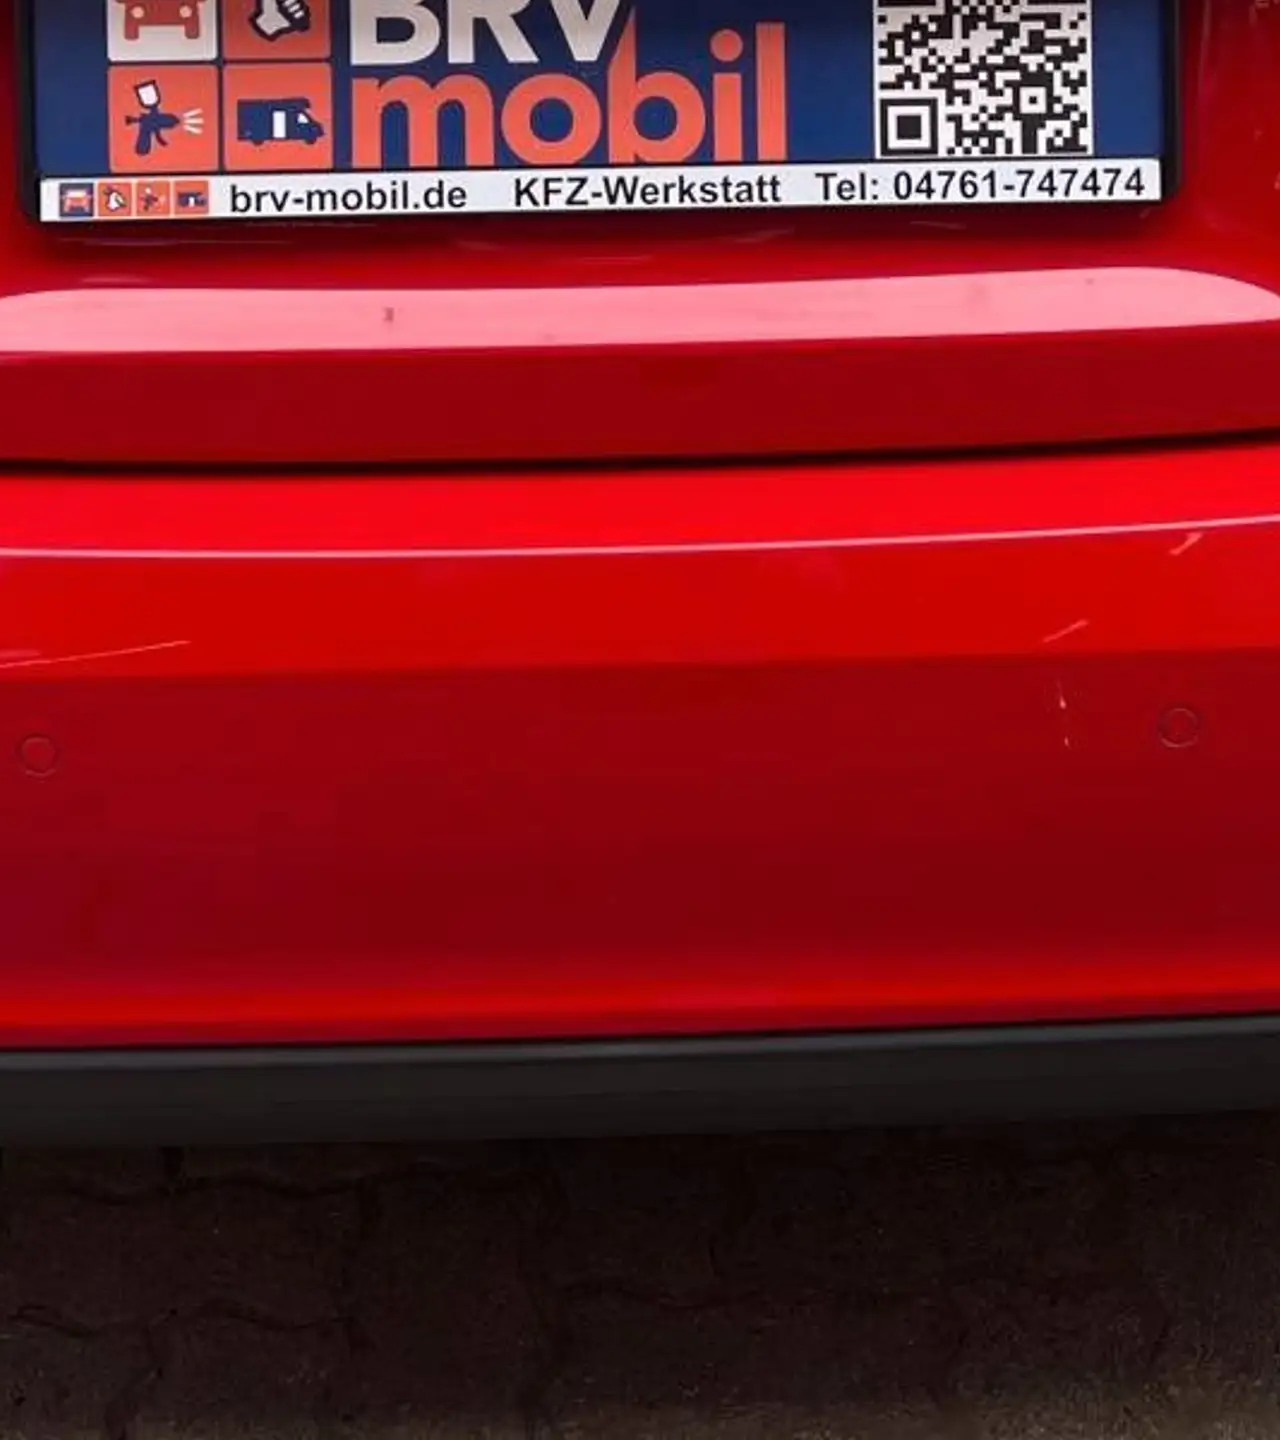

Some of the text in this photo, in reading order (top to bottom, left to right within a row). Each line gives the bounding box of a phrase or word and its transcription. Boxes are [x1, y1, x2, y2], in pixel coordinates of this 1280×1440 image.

[350, 6, 789, 170] mobil
[230, 167, 1145, 213] brv-mobil.de KFZ-Werkstatt Tel: 04761-747474
